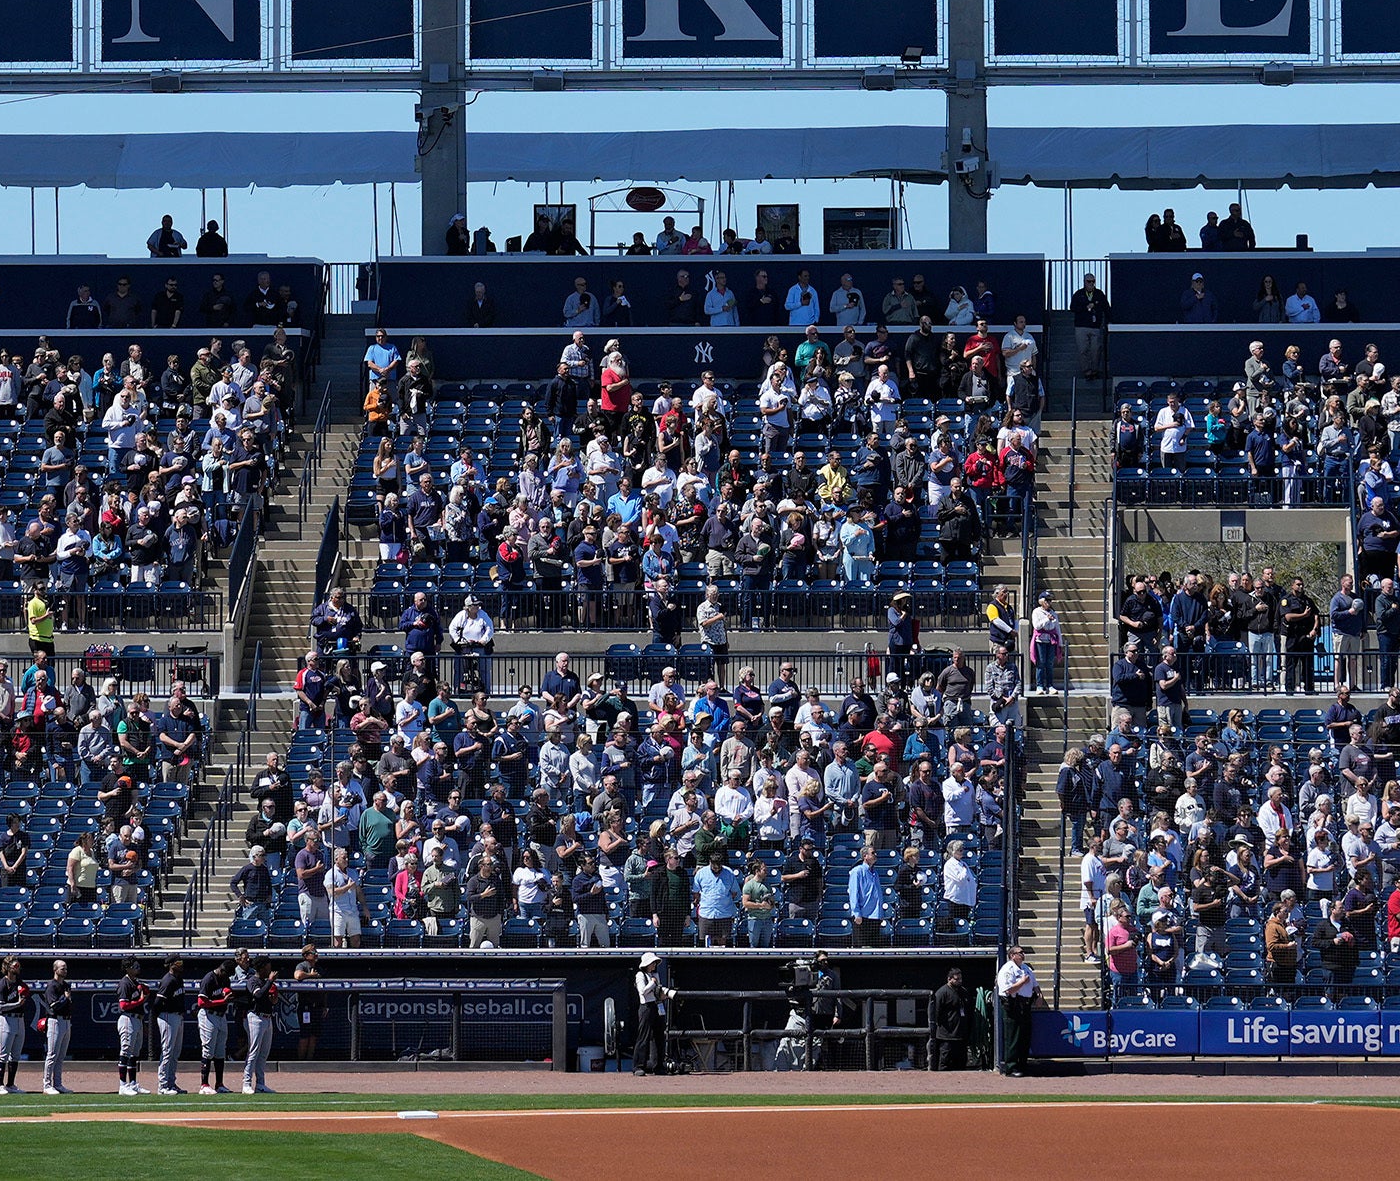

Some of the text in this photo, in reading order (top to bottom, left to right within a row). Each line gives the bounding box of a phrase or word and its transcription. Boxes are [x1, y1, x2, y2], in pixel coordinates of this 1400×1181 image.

[694, 341, 715, 363] NY
[1227, 529, 1241, 540] EXIT
[1093, 1029, 1177, 1053] BayCare
[1227, 1017, 1384, 1052] Life-saving
